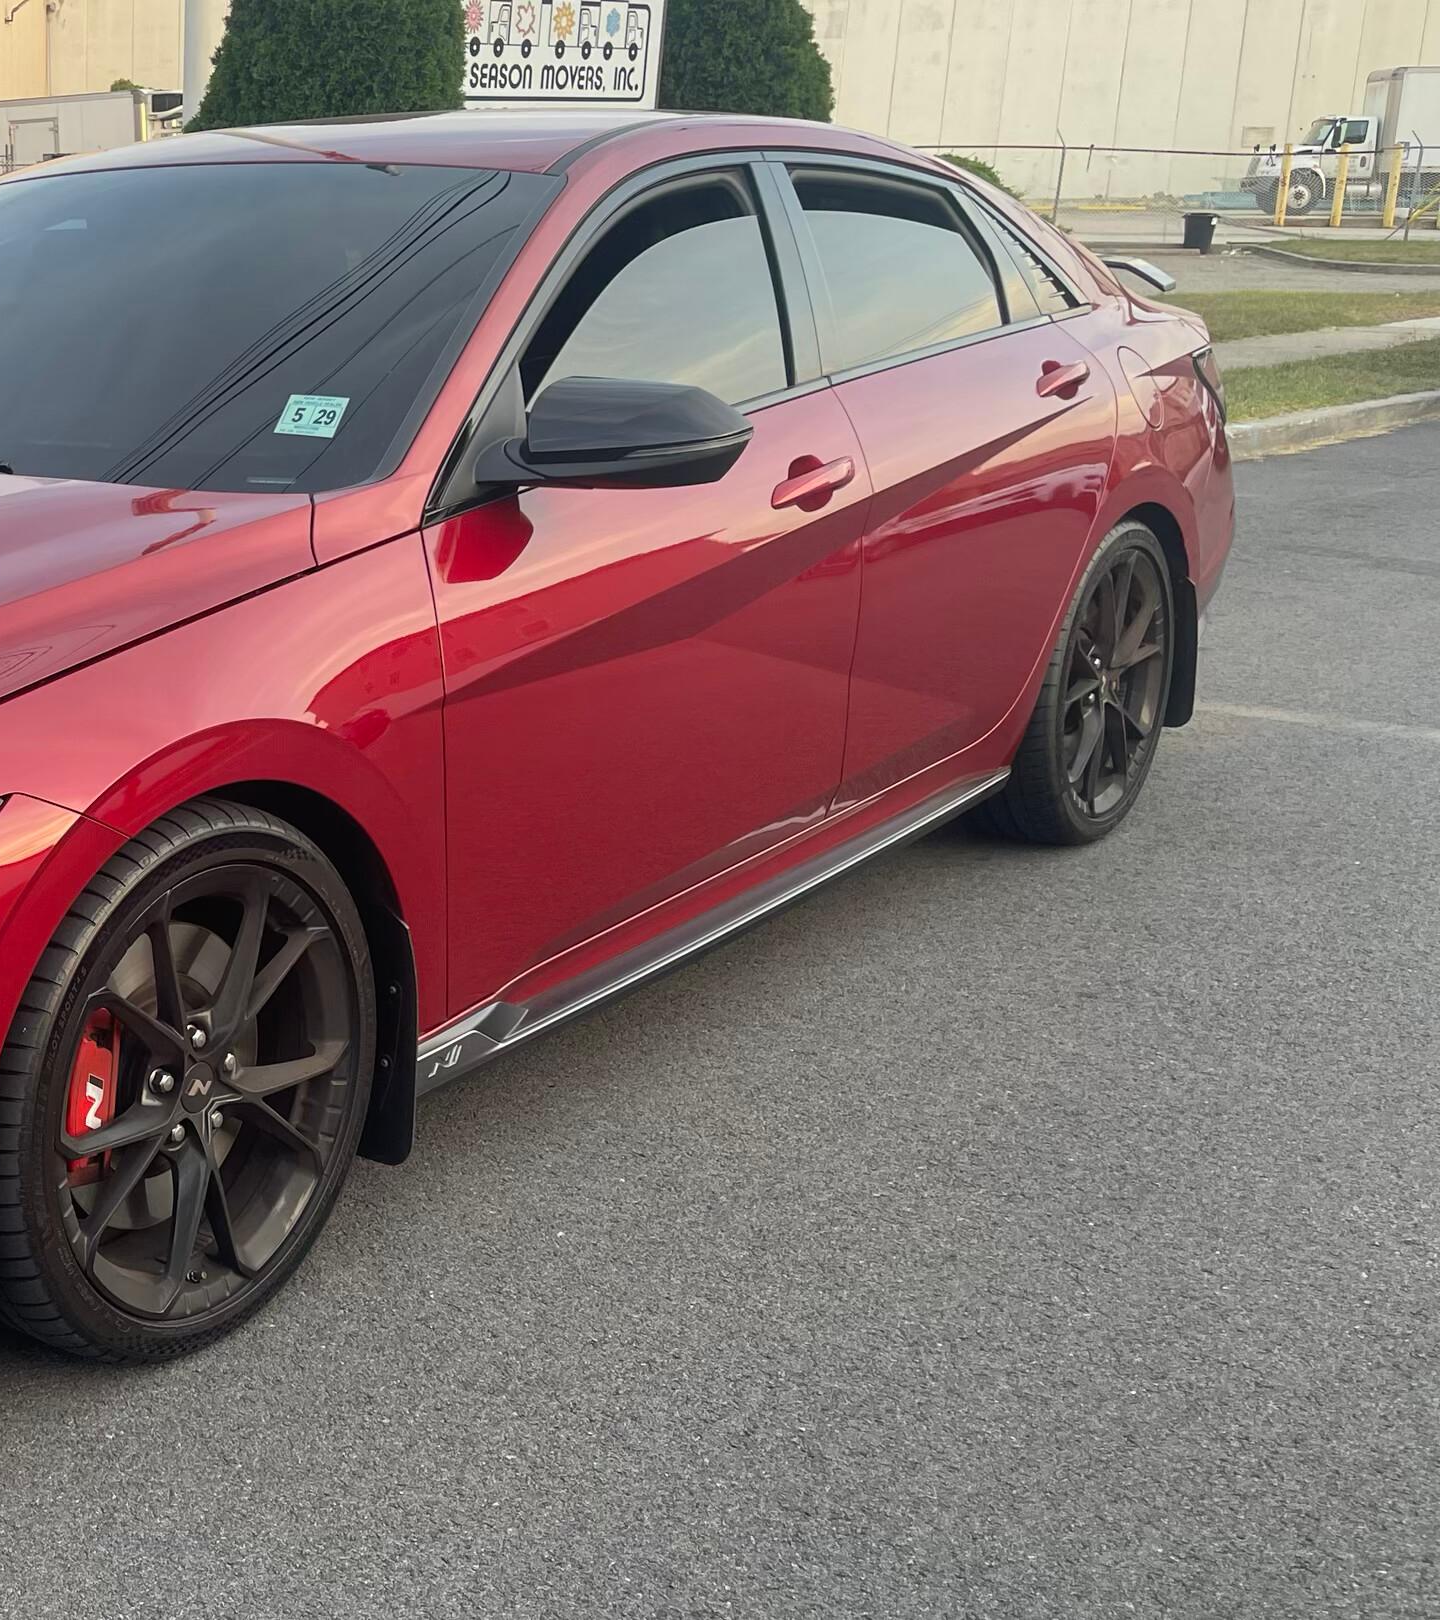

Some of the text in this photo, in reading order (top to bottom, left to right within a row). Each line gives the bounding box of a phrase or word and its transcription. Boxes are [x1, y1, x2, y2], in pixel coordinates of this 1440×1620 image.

[469, 62, 639, 92] SEASON MOVERS, INC.
[292, 407, 306, 422] 5
[313, 409, 336, 425] 29
[58, 983, 80, 1029] SPORT
[185, 1078, 212, 1096] N
